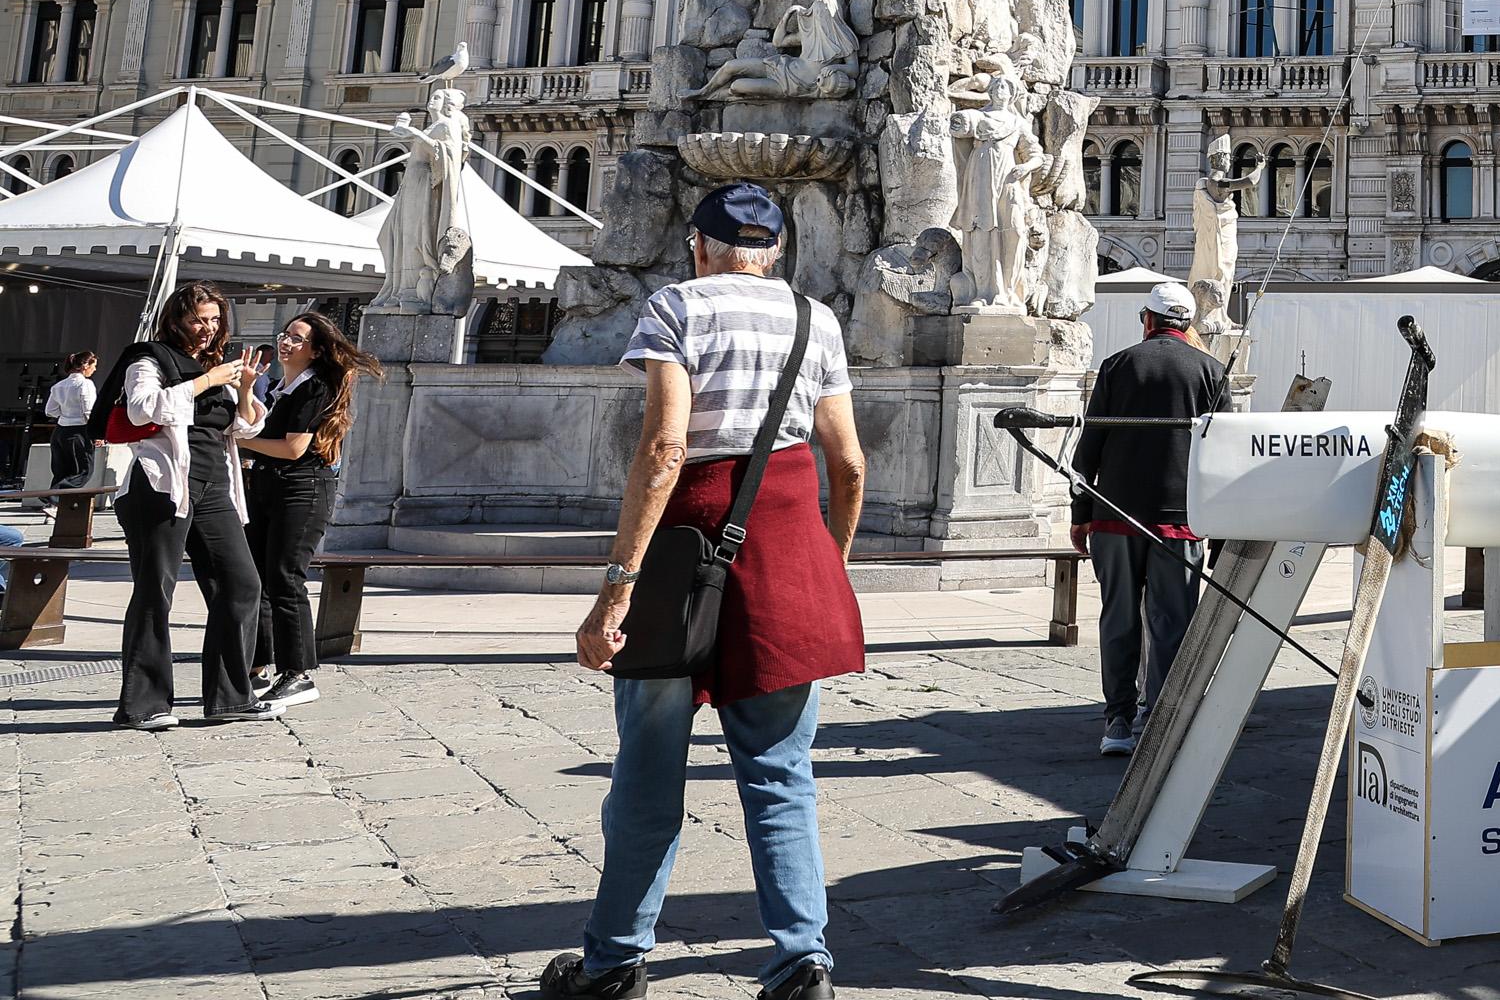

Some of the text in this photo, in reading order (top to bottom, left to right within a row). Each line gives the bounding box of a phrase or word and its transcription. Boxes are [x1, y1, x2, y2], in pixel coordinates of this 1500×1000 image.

[1251, 434, 1372, 456] NEVERINA
[1387, 475, 1399, 506] XM
[1394, 465, 1409, 509] TECH
[1382, 686, 1421, 710] UNIVERSITÀ
[1382, 702, 1422, 724] DEGLI STUDI
[1382, 716, 1415, 737] DI TRIESTE
[1390, 780, 1419, 798] dipartimento
[1390, 792, 1418, 810] di ingegneria
[1393, 805, 1420, 822] architettura
